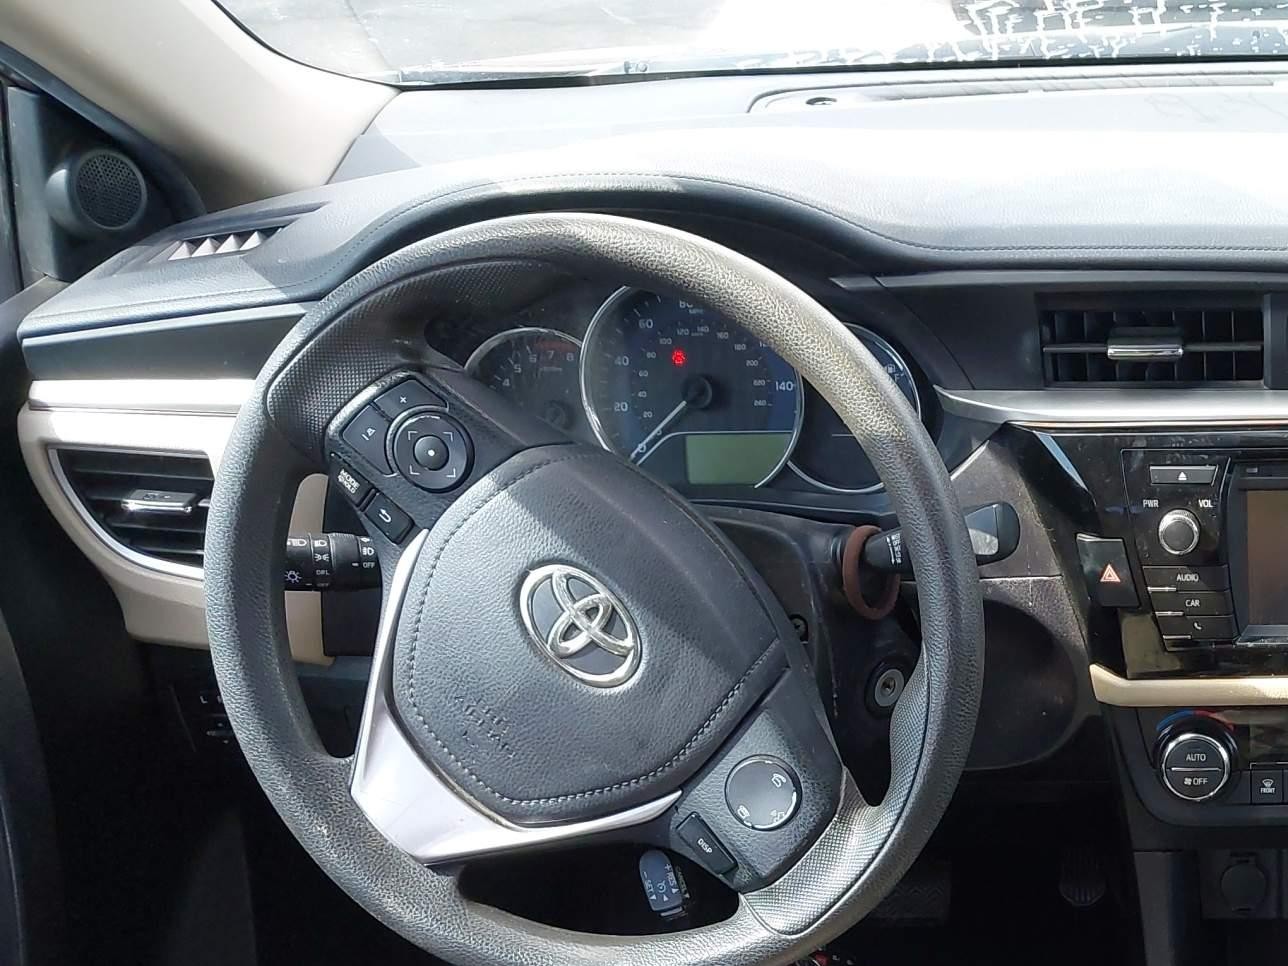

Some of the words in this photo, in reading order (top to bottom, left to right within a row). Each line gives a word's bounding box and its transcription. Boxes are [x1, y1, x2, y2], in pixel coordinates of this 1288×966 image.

[638, 318, 653, 329] 60
[547, 350, 555, 359] 7
[566, 353, 574, 361] 8
[614, 356, 629, 366] 40
[514, 364, 522, 373] 5
[639, 370, 648, 378] 60
[502, 378, 510, 387] 4
[775, 381, 793, 391] 140
[614, 402, 629, 412] 20
[340, 468, 361, 490] MODE
[1142, 499, 1160, 508] PWR
[1198, 499, 1214, 508] VOL
[362, 561, 375, 569] OFF
[1176, 573, 1199, 582] AUDIO
[1185, 599, 1201, 607] CAR
[1185, 752, 1206, 762] AUTO
[1193, 776, 1209, 786] OFF
[1260, 786, 1276, 794] FRONT
[697, 838, 713, 854] DISP
